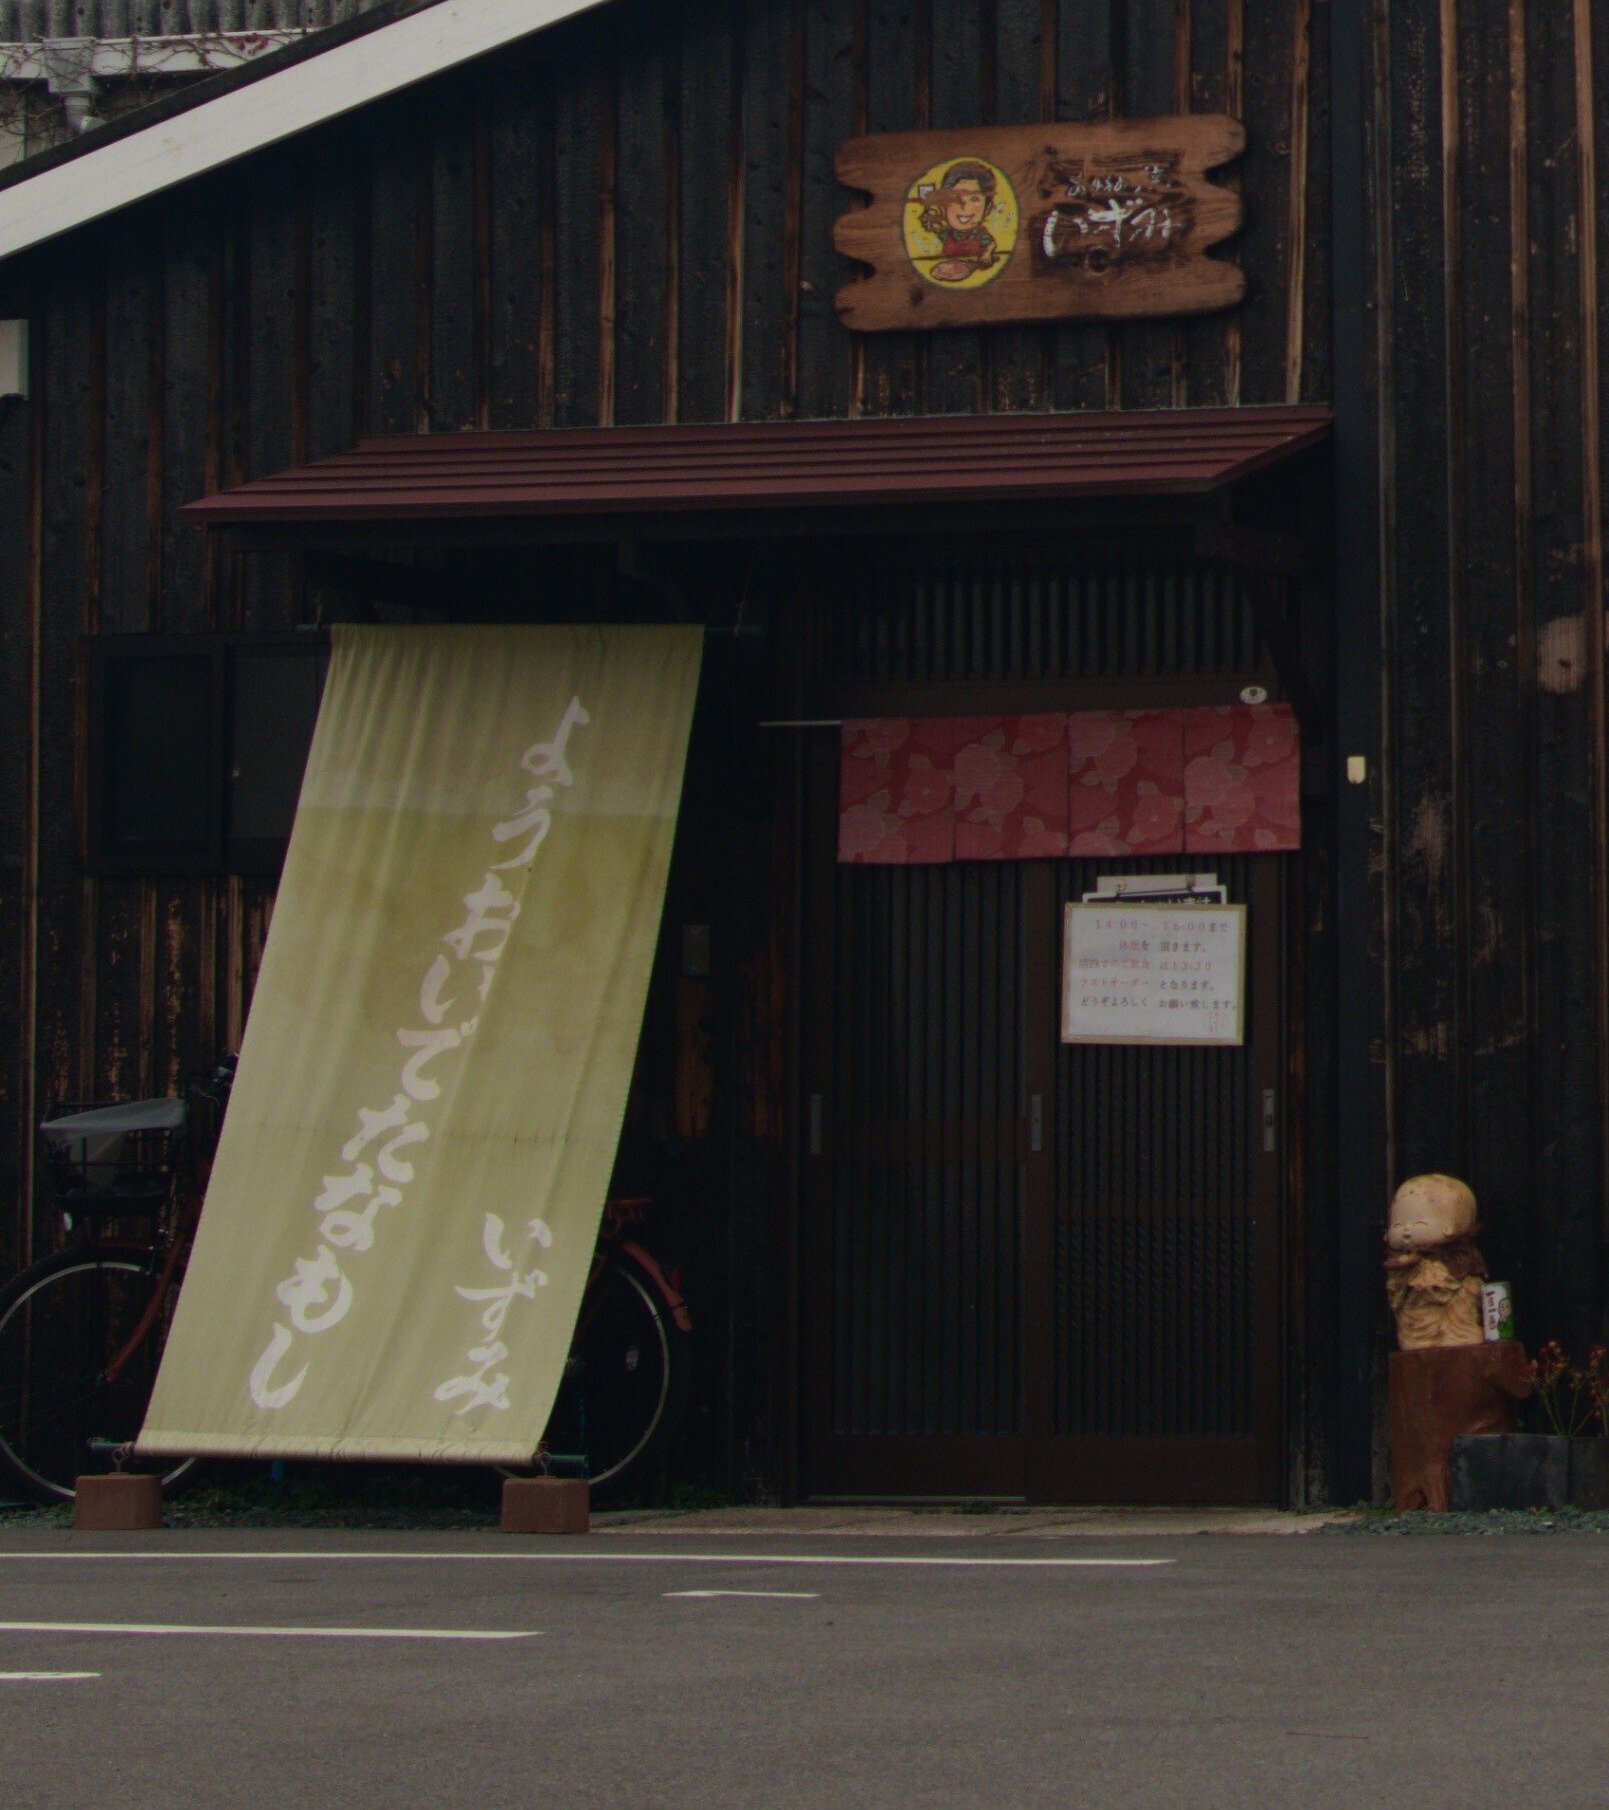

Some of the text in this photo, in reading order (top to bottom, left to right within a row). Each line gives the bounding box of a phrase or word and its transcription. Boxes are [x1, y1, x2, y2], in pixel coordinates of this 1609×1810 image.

[249, 694, 590, 1410] ようおいでたなもし
[434, 1212, 550, 1415] いずみ
